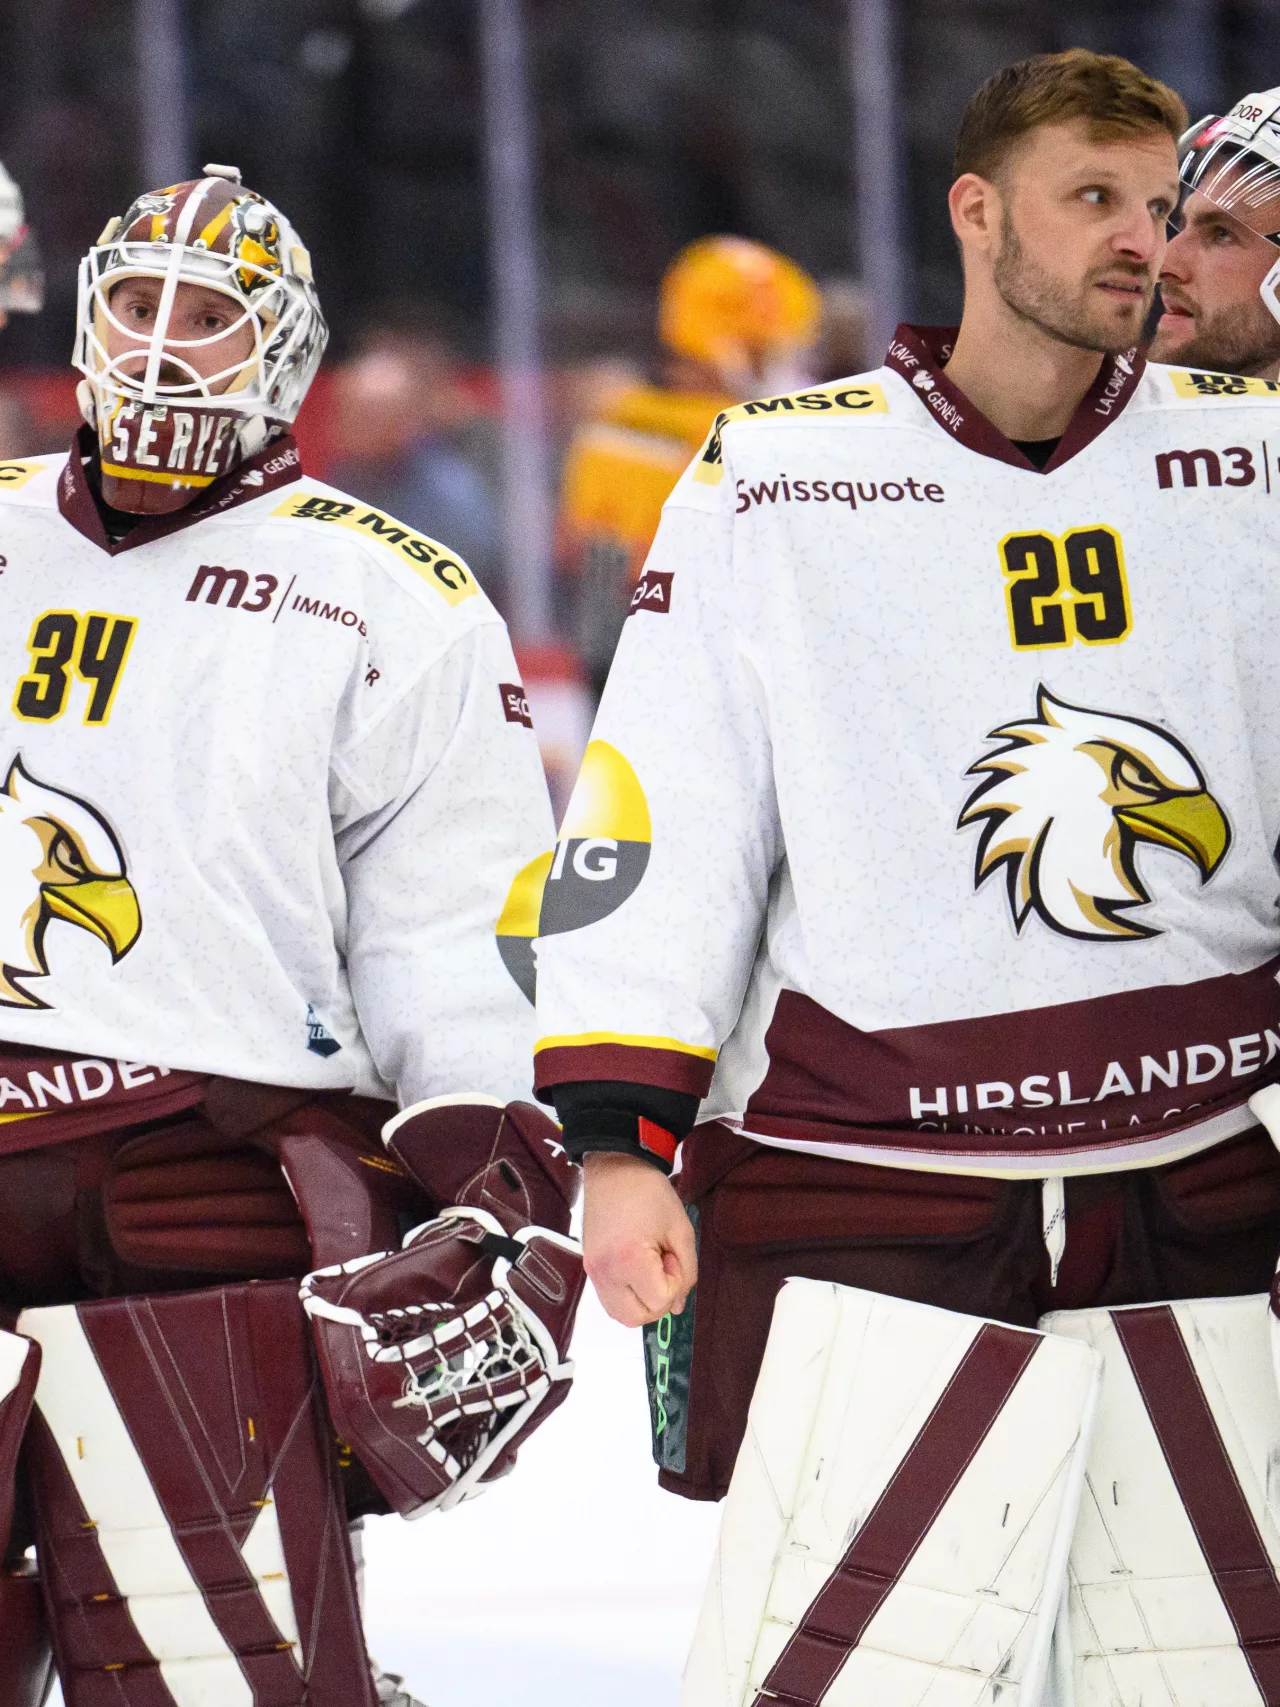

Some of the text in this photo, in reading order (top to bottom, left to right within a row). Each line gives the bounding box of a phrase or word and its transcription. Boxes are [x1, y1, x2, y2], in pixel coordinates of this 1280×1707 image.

[1232, 104, 1263, 123] DOR
[743, 390, 875, 416] MSC
[1155, 446, 1256, 490] m3
[736, 473, 946, 513] Swissquote
[357, 513, 468, 591] MSC
[185, 563, 279, 612] m3
[997, 523, 1134, 652] 29
[11, 609, 140, 727] 34
